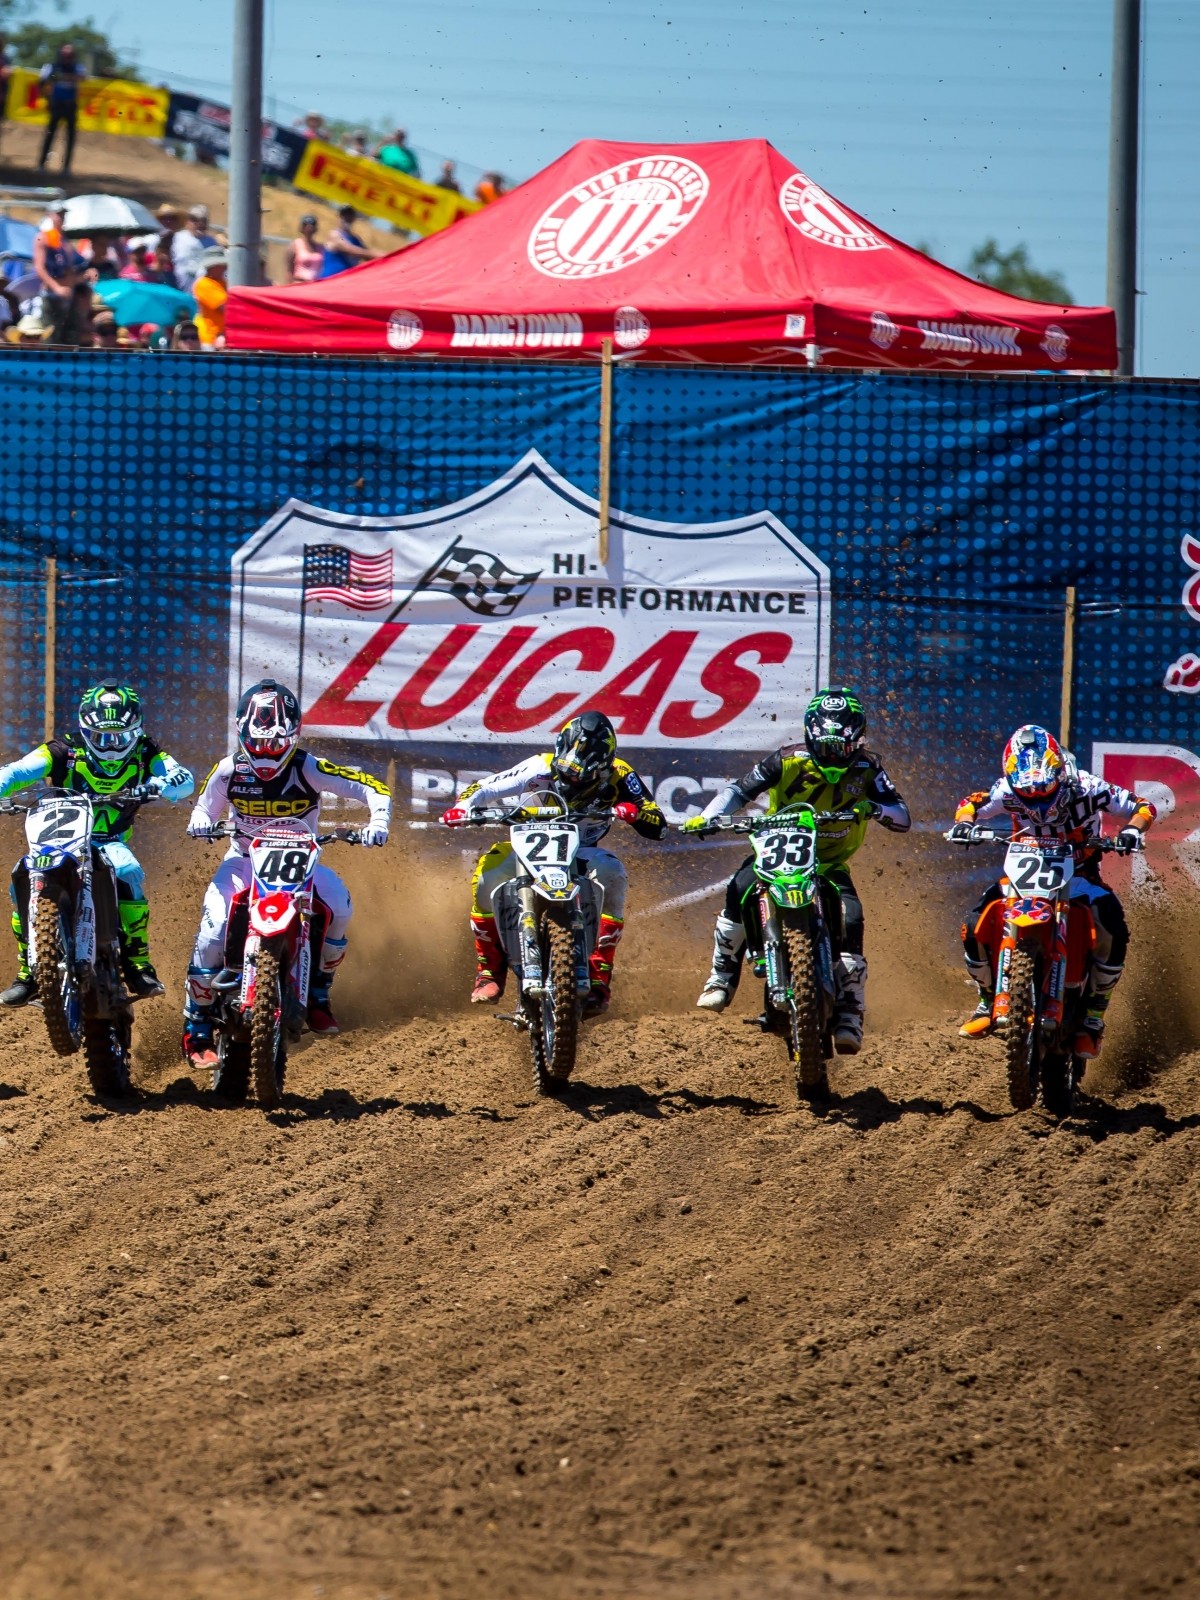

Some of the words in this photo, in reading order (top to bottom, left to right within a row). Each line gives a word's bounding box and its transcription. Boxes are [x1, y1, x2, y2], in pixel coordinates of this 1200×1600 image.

[451, 313, 583, 347] HANGTOWN
[553, 586, 806, 615] PERFORMANCE
[302, 622, 793, 739] LUCAS
[232, 798, 310, 817] GEICO
[37, 808, 80, 843] 2
[525, 832, 569, 862] 21
[761, 833, 812, 871] 33
[258, 850, 308, 883] 48
[1015, 856, 1064, 890] 25
